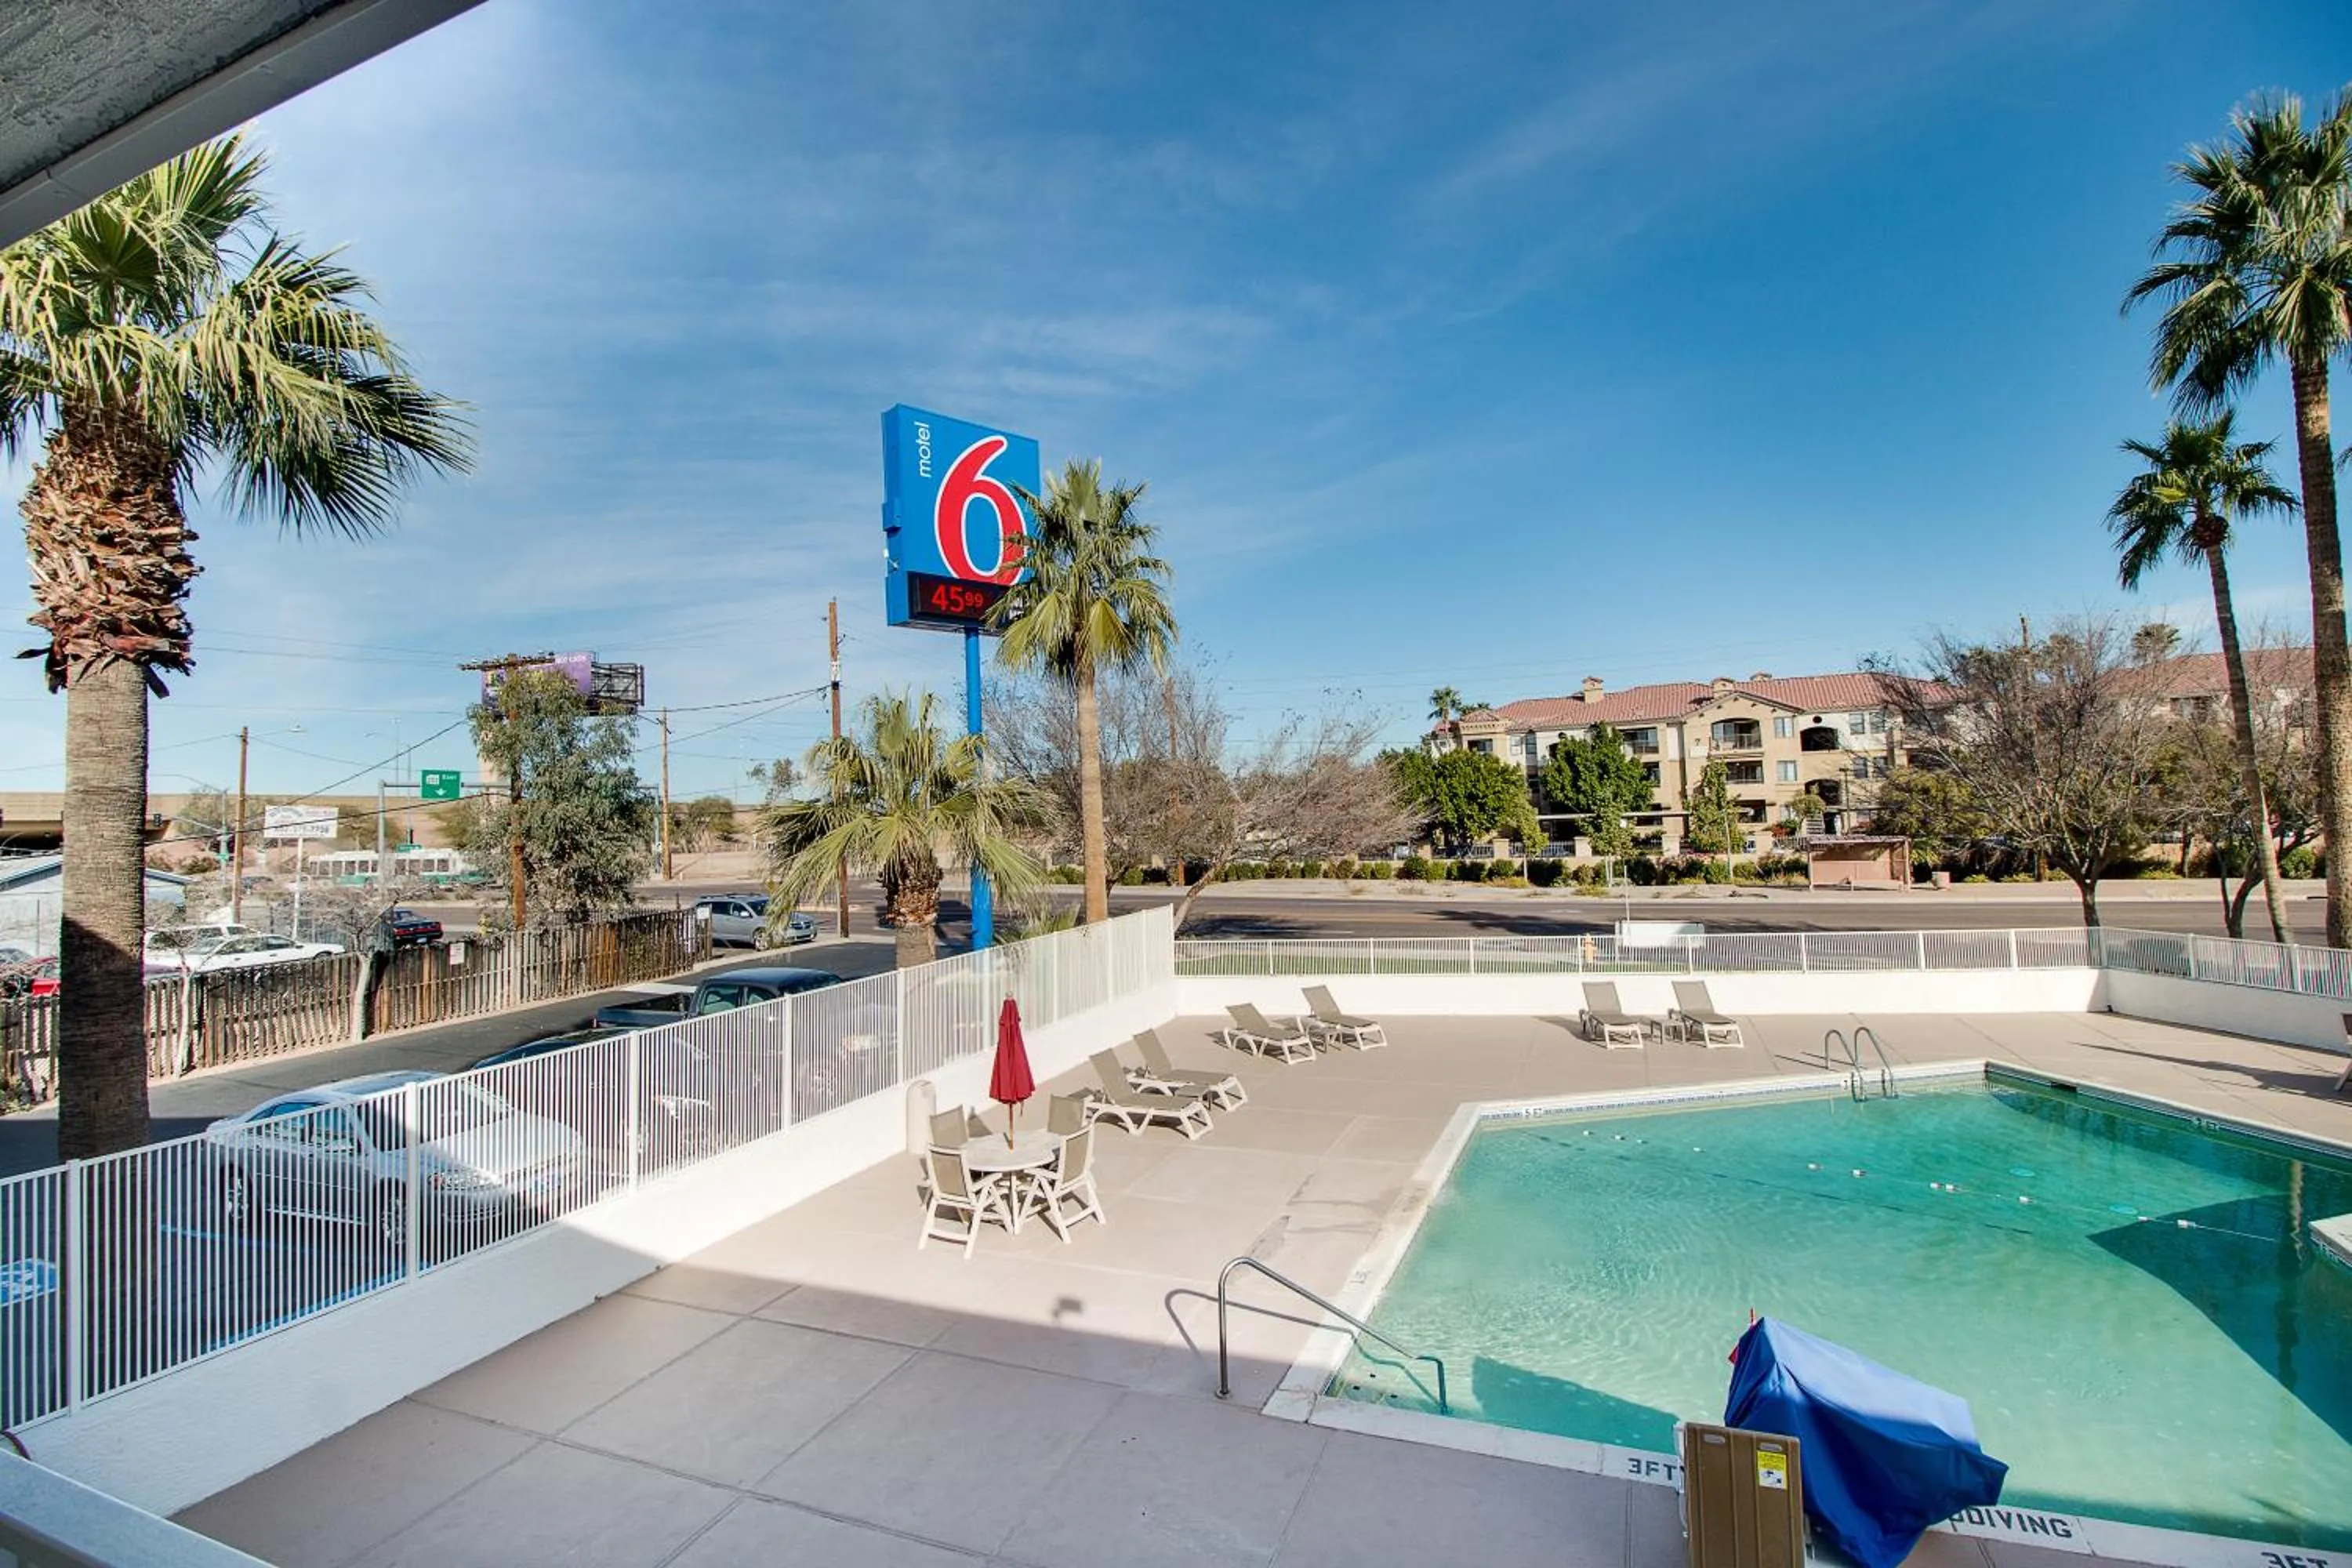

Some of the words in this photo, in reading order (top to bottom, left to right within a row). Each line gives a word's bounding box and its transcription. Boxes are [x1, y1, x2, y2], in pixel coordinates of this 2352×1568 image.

[913, 421, 931, 477] motel
[935, 436, 1027, 585] 6
[932, 584, 964, 612] 45
